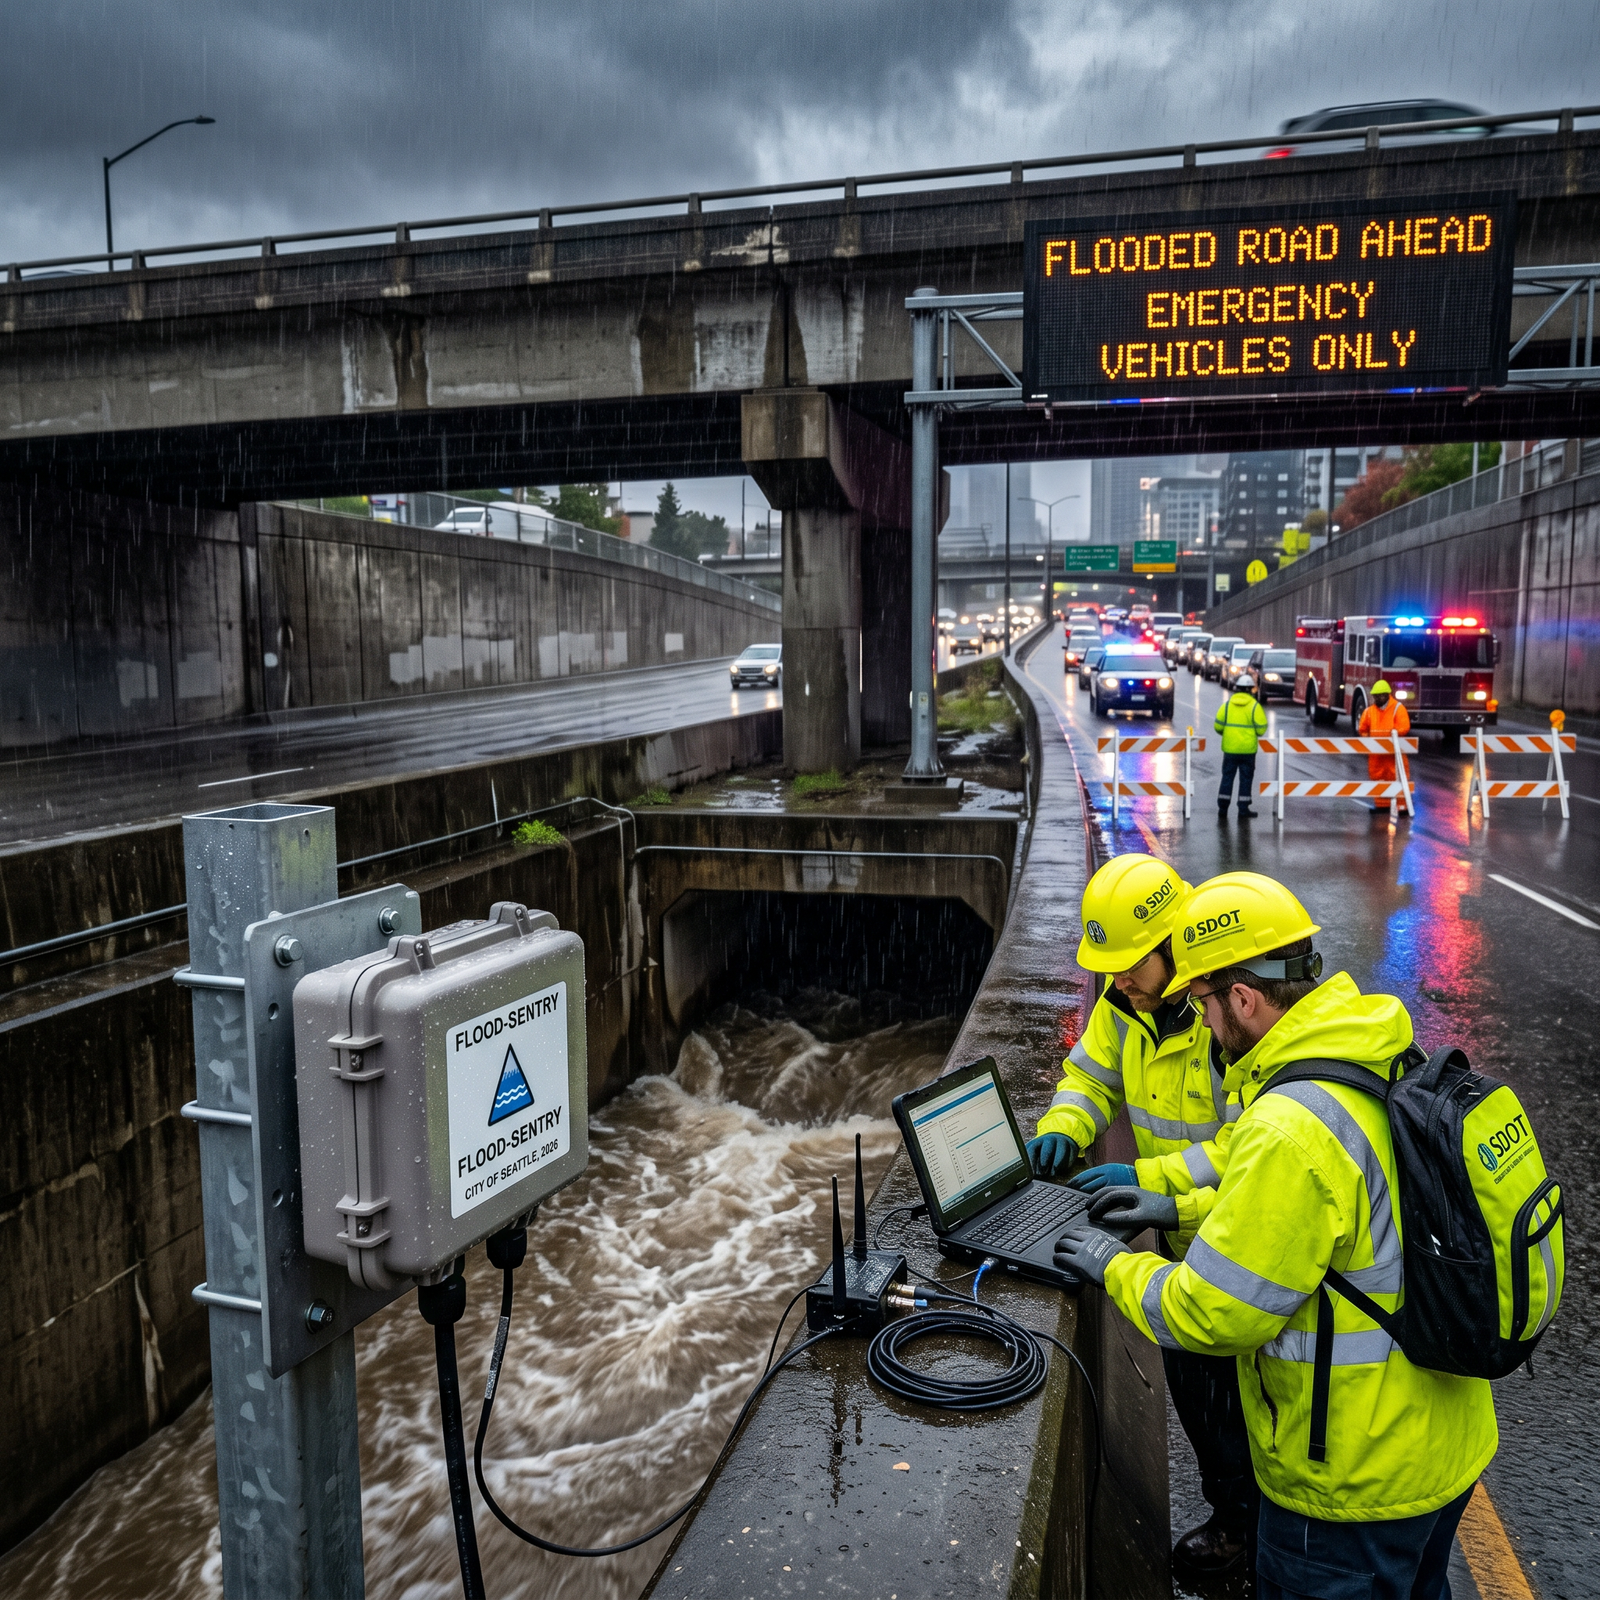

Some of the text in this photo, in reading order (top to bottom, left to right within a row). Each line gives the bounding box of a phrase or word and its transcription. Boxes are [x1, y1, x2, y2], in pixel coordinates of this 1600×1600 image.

[1045, 214, 1492, 276] FLOODED ROAD AHEAD
[1147, 280, 1374, 328] EMERGENCY
[1102, 330, 1416, 379] VEHICLES ONLY
[1145, 879, 1173, 909] SDOT
[1196, 909, 1241, 936] SDOT
[455, 992, 559, 1052] FLOOD-SENTRY
[458, 1106, 562, 1178] FLOOD-SENTRY
[1489, 1114, 1528, 1158] SDOT
[465, 1138, 559, 1200] CITY OF SEATTLE, 2026
